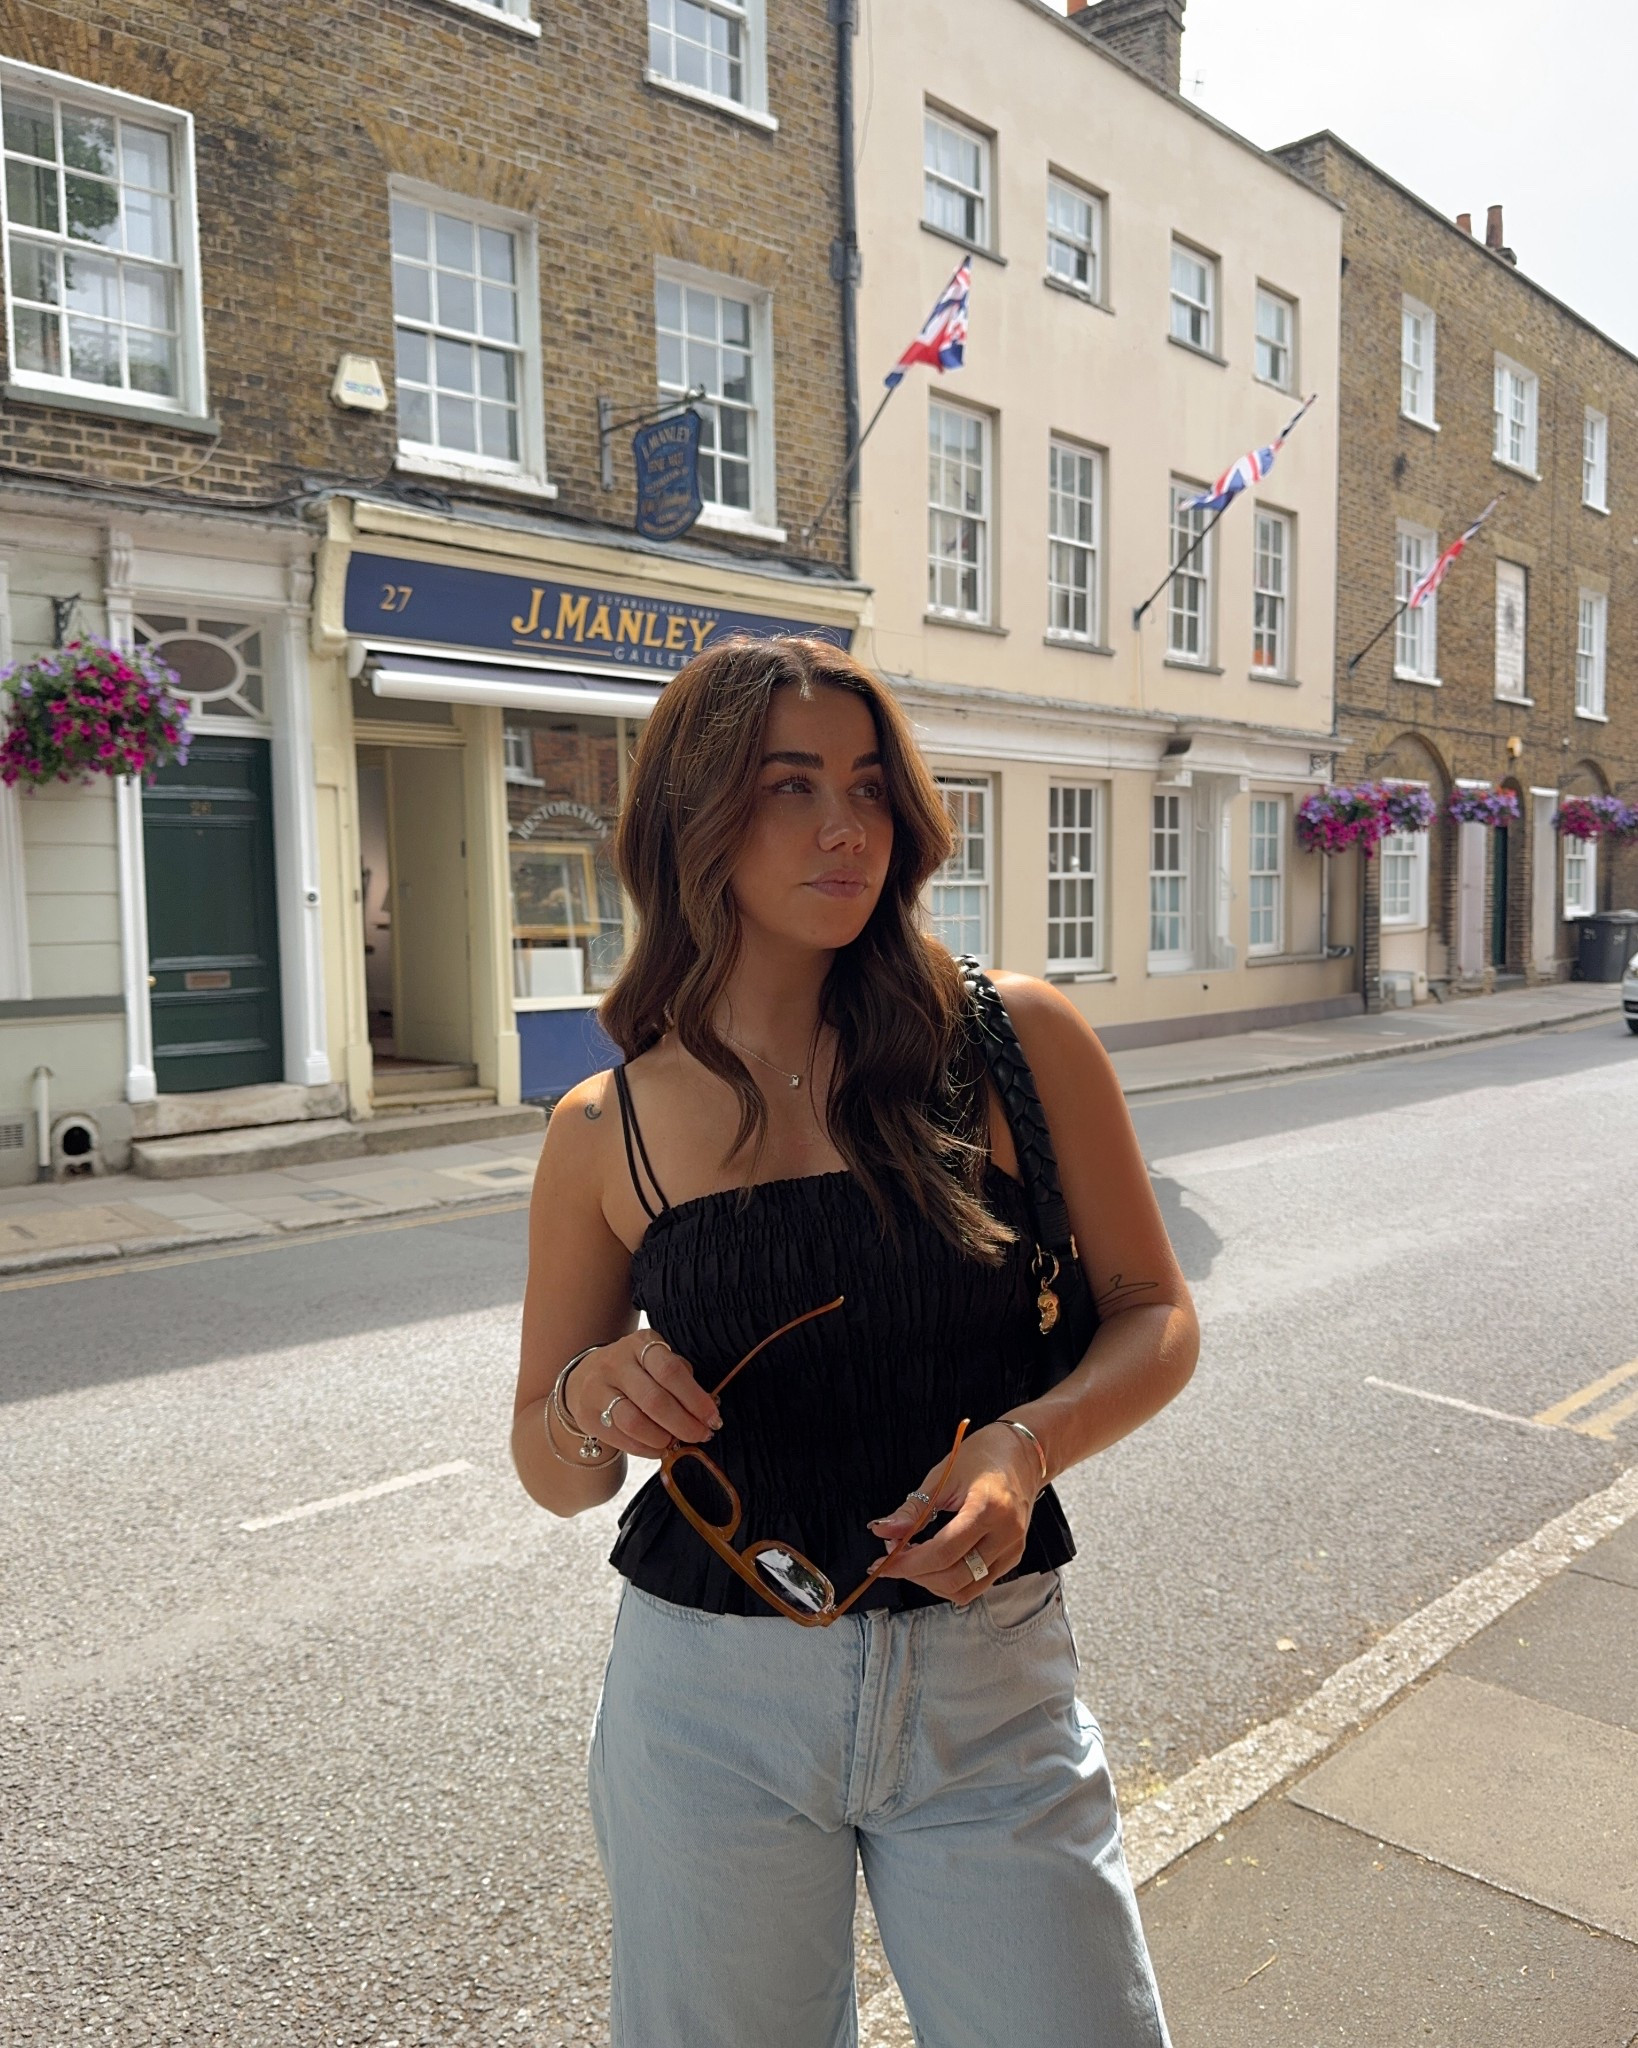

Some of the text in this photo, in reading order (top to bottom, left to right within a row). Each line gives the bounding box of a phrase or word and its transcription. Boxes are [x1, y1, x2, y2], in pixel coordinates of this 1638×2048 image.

[379, 583, 413, 613] 27
[598, 594, 684, 616] ESTABLISHED
[613, 646, 690, 668] GALLER
[517, 801, 608, 840] RESTORATION
